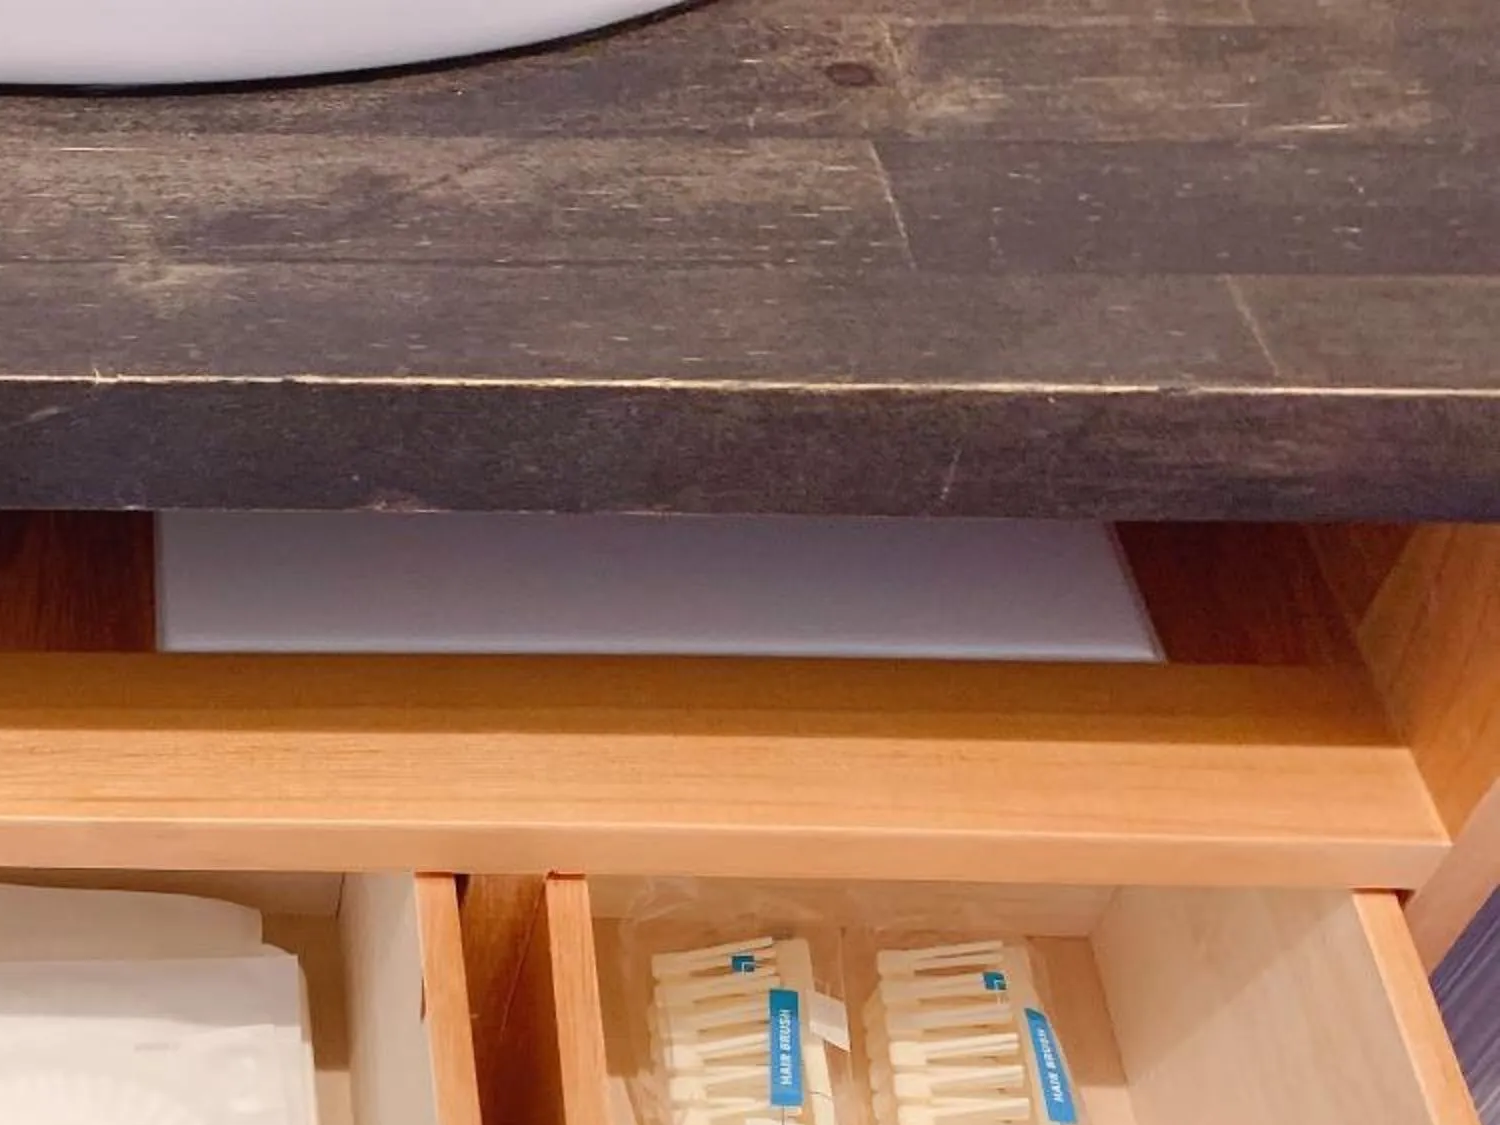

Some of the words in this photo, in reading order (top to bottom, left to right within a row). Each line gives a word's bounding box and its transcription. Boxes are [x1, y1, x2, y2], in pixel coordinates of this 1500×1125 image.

[779, 1009, 792, 1051] BRUSH
[780, 1053, 792, 1085] HAIR
[1048, 1072, 1064, 1102] HAIR
